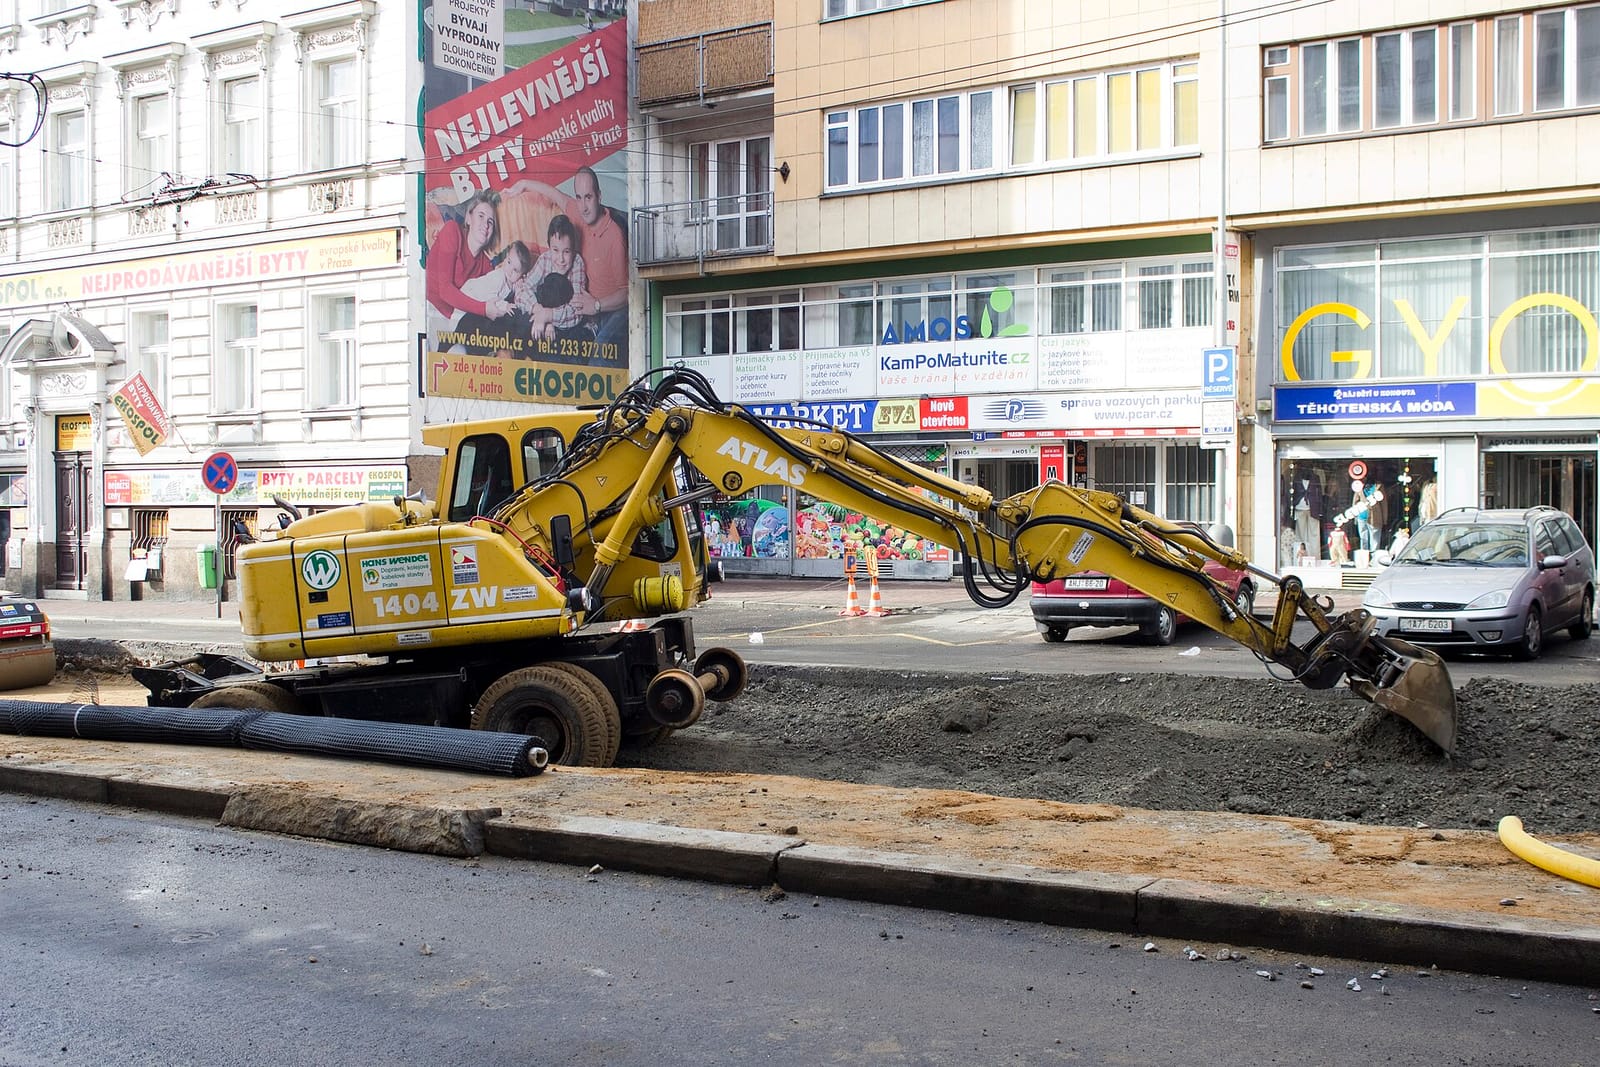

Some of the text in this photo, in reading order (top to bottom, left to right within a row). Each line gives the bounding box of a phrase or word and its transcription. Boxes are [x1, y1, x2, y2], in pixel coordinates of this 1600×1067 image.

[451, 13, 488, 34] BÝVAJÍ
[437, 24, 501, 53] VYPRODÁNY
[441, 41, 497, 66] DLOUHO PŘED
[443, 54, 496, 77] DOKONČENÍM
[433, 38, 611, 163] NEJLEVNĚJŠÍ
[449, 99, 616, 204] BYTY evropské kvality
[581, 123, 623, 157] v Praze
[319, 236, 392, 257] evropské kvality
[81, 250, 254, 294] NEJPRODÁVANĚJŠÍ
[259, 249, 310, 275] BYTY
[327, 256, 353, 270] Praze
[437, 327, 523, 353] www.ekospol.cz
[881, 314, 972, 346] AMOS
[538, 336, 618, 360] tel.: 233 372 021
[453, 357, 503, 376] zde v domě
[881, 350, 1030, 371] KamPoMaturite.cz
[1208, 353, 1229, 383] P
[468, 377, 504, 397] 4. patro
[513, 366, 616, 401] EKOSPOL
[880, 373, 907, 385] Vaše
[974, 368, 1029, 381] vzdělání
[127, 383, 144, 409] BYTY
[930, 399, 955, 412] Nově
[1297, 400, 1456, 414] TĚHOTENSKÁ MÓDA
[114, 395, 160, 445] EKOSPOL
[753, 402, 867, 431] MARKET
[878, 404, 917, 425] EVA
[922, 414, 966, 428] otevřeno
[1094, 409, 1173, 422] www.pcar.cz
[716, 436, 808, 486] ATLAS
[262, 472, 295, 486] BYTY
[307, 471, 364, 485] PARCELY
[368, 470, 403, 480] EKOSPOL
[276, 487, 342, 501] nejvýhodnější
[343, 490, 366, 500] ceny
[373, 591, 440, 618] 1404
[451, 585, 498, 610] ZW
